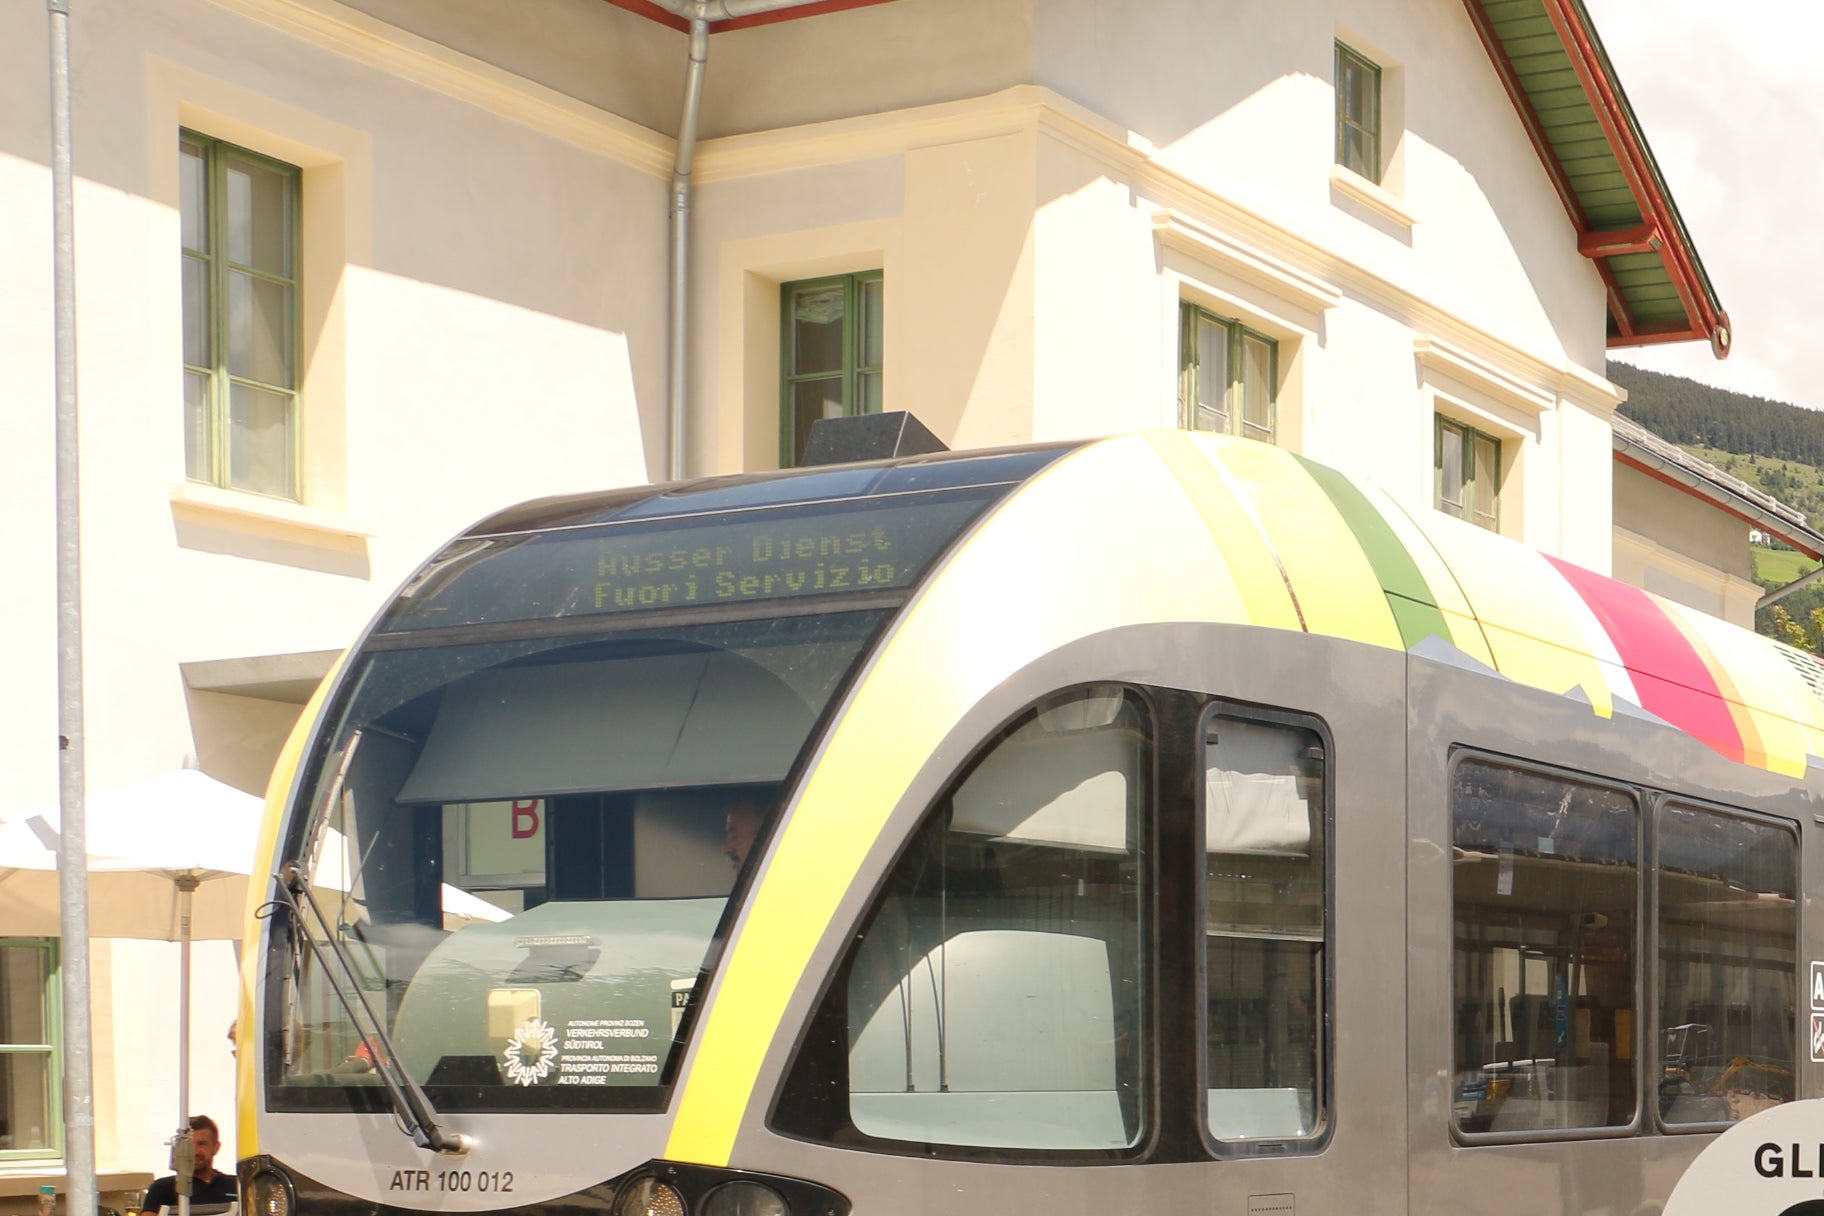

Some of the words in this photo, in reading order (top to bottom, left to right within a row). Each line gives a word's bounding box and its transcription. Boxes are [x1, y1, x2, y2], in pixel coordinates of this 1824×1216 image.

[752, 529, 892, 562] Dienst
[594, 575, 697, 608] Fuori
[715, 559, 895, 597] Servizio
[512, 799, 539, 839] B
[1813, 971, 1824, 1001] A
[563, 1039, 605, 1050] SÜDTIROL
[566, 1028, 649, 1038] VERKEHRSVERBUND
[560, 1063, 610, 1073] TRASPORTO
[610, 1063, 658, 1073] INTEGRATO
[558, 1075, 580, 1085] ALTO
[580, 1075, 607, 1085] ADIGE
[389, 1170, 430, 1191] ATR
[438, 1171, 472, 1192] 100
[477, 1171, 514, 1193] 012
